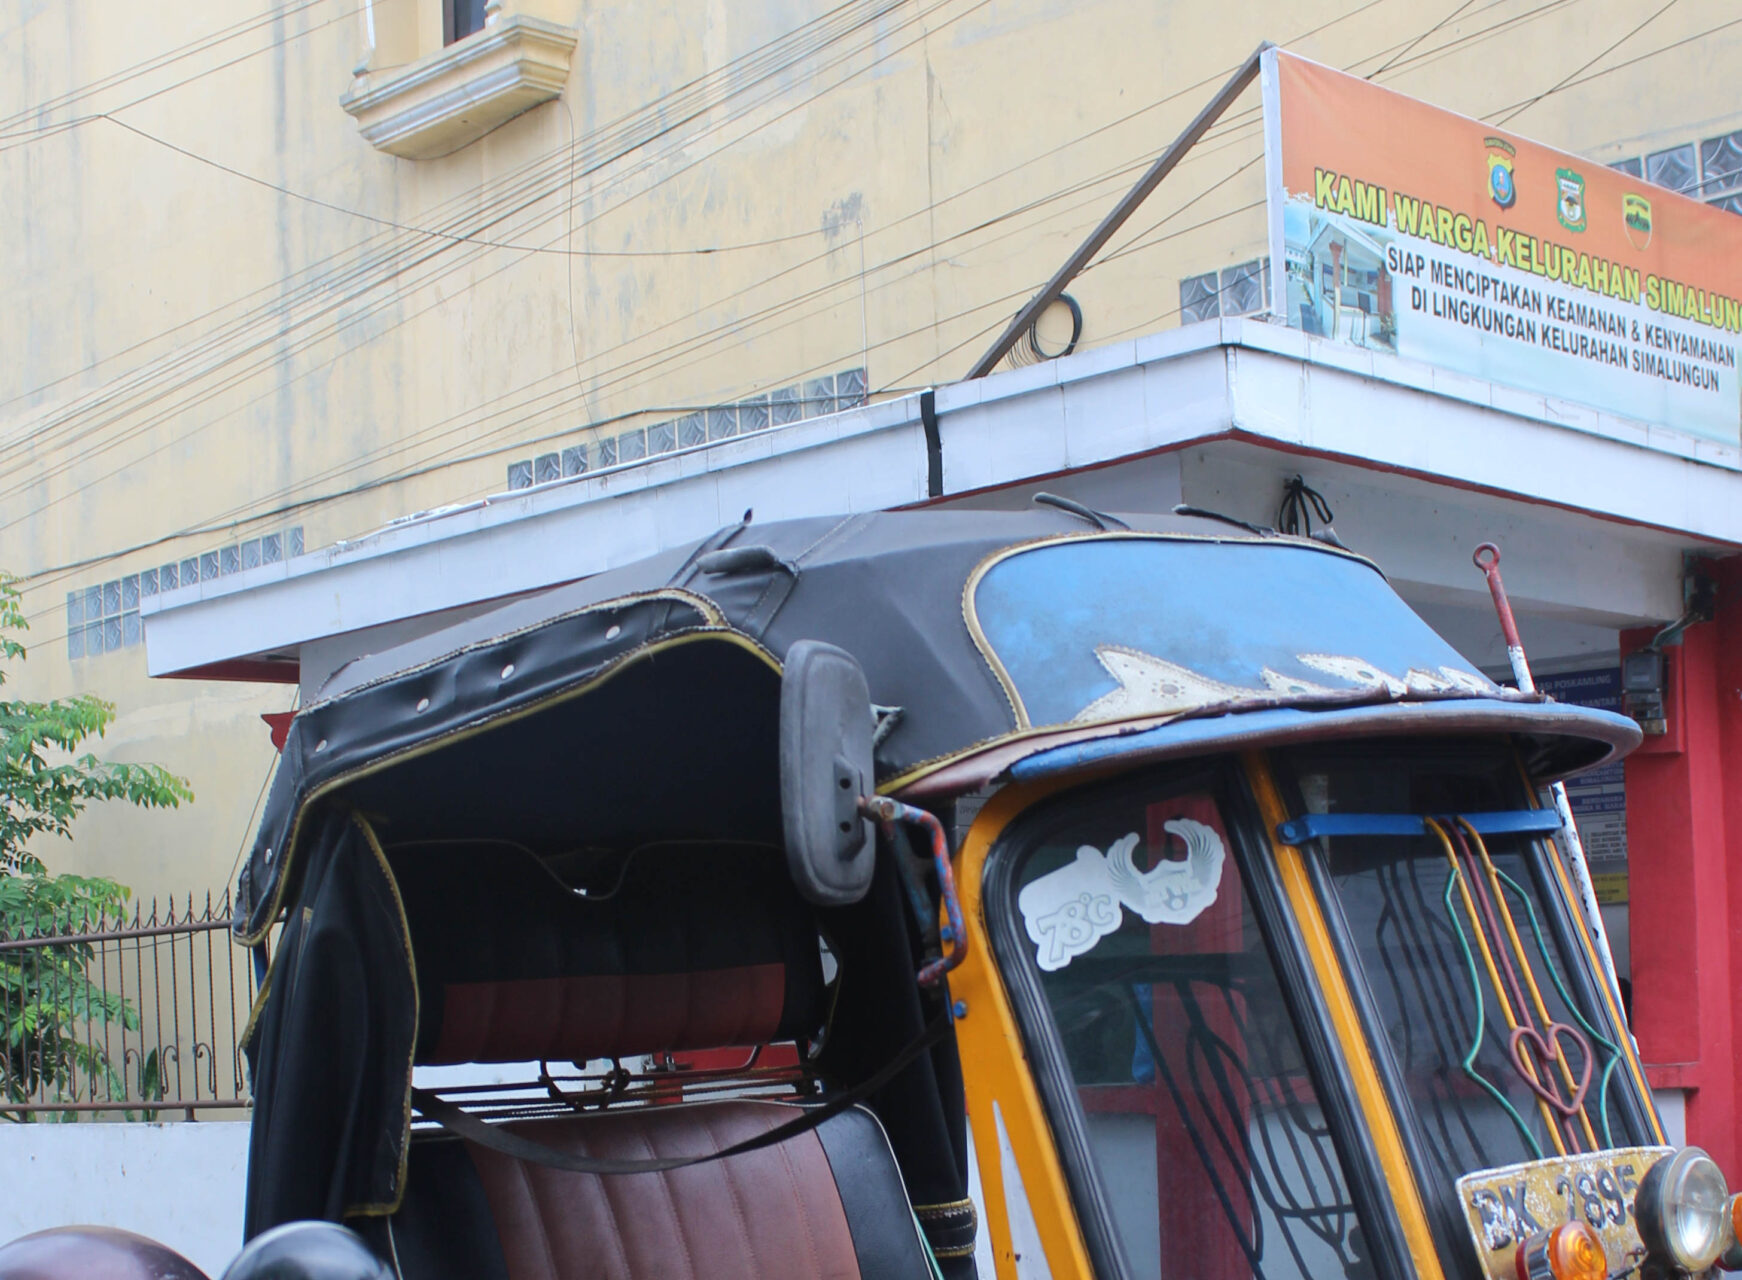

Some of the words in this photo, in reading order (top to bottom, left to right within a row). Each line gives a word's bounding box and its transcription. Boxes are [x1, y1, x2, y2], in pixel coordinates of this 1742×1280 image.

[1314, 167, 1388, 228] KAMI
[1393, 191, 1492, 261] WARGA
[1497, 225, 1641, 306] KELURAHAN
[1645, 273, 1742, 334] SIMALUN
[1388, 246, 1425, 279] SIAP
[1430, 258, 1542, 315] MENCIPTAKAN
[1547, 294, 1627, 339] KEAMANAN
[1631, 319, 1641, 342] &
[1644, 323, 1736, 369] KENYAMANAN
[1411, 285, 1427, 313] DI
[1432, 290, 1537, 345] LINGKUNGAN
[1541, 324, 1629, 369] KELURAHAN
[1632, 349, 1720, 393] SIMALUNGUN
